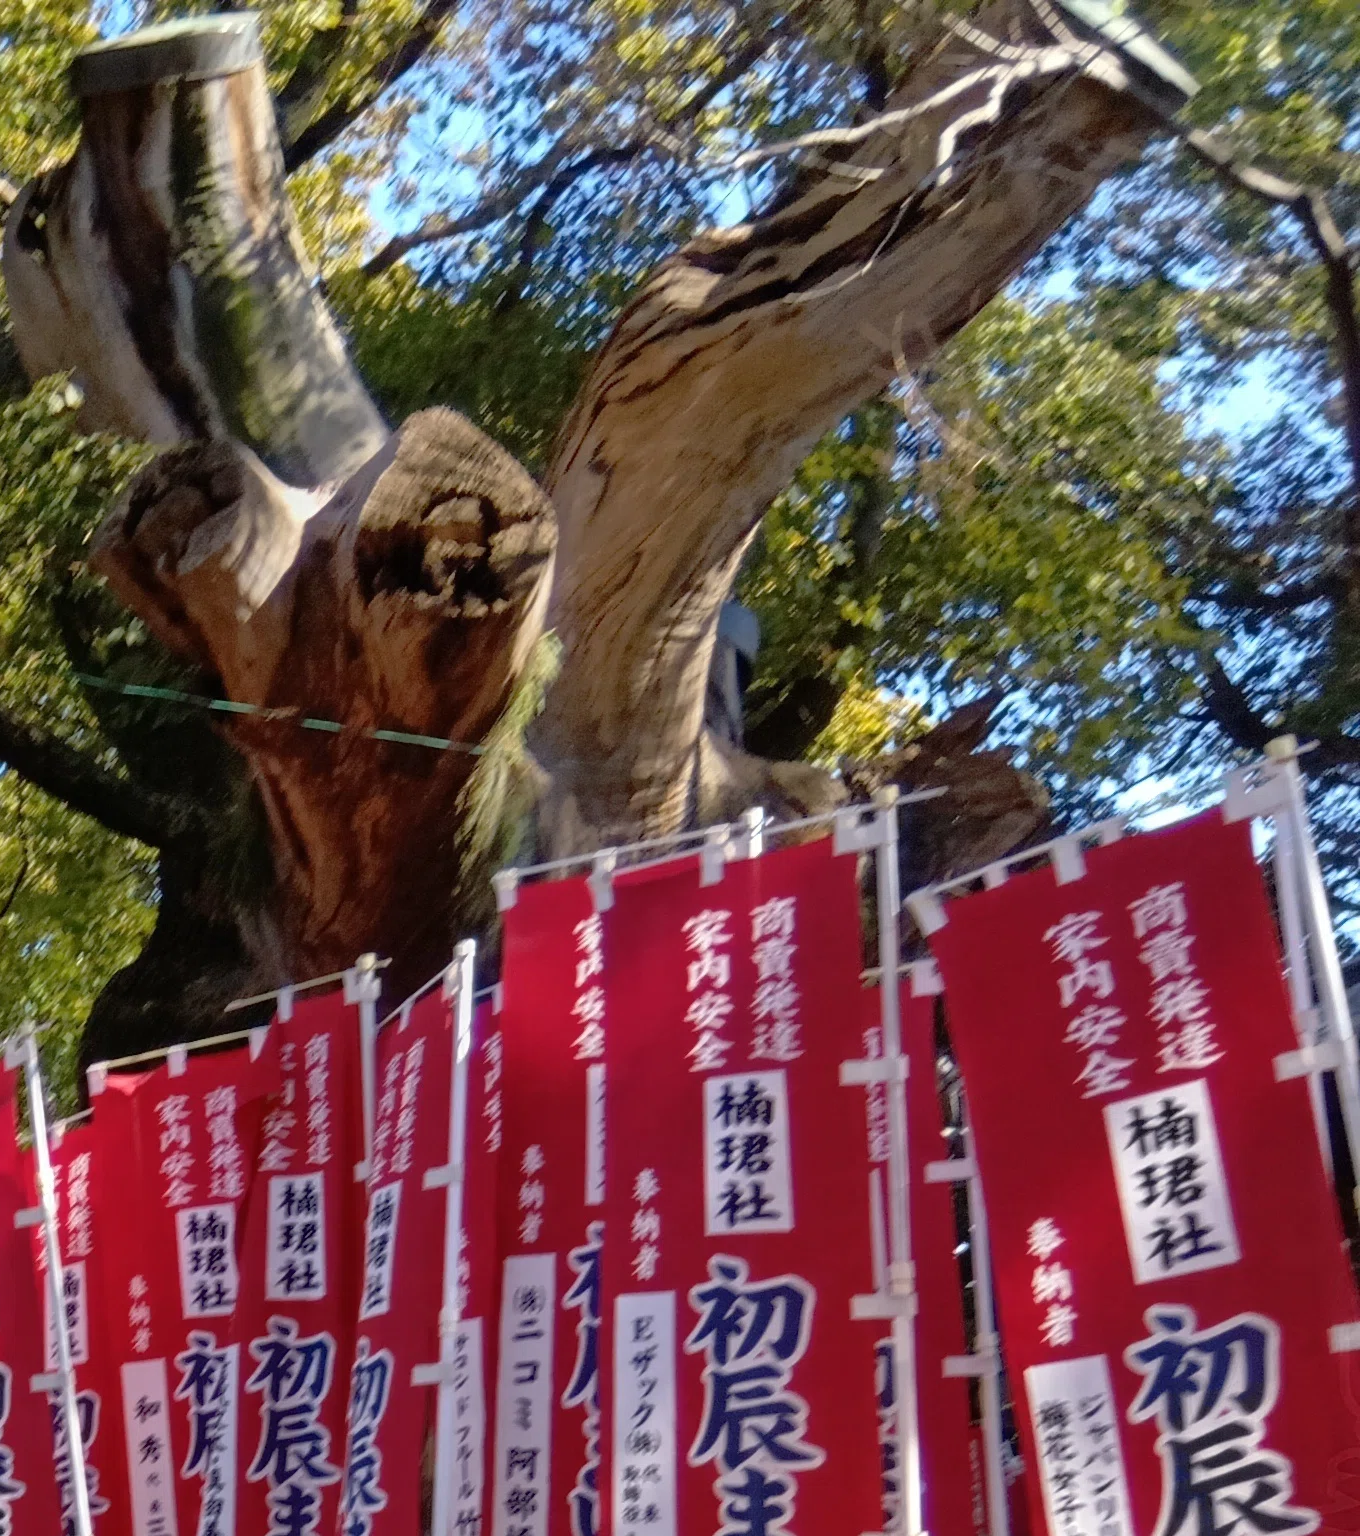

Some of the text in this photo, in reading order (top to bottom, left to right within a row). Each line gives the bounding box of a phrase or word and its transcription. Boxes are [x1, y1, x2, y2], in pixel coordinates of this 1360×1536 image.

[681, 909, 736, 1073] 家内安全
[1041, 909, 1138, 1099] 家内安全
[154, 1094, 198, 1208] 家内安全
[368, 1052, 404, 1187] 家内安全
[714, 1079, 782, 1228] 楠珺社
[275, 1179, 322, 1296] 楠珺社
[518, 1143, 546, 1244] 奉納者
[630, 1167, 662, 1282] 奉納者
[1121, 1097, 1227, 1272] 楠珺社
[128, 1273, 152, 1354] 奉納者
[183, 1211, 237, 1314] 楠珺社
[1025, 1216, 1078, 1348] 奉納者
